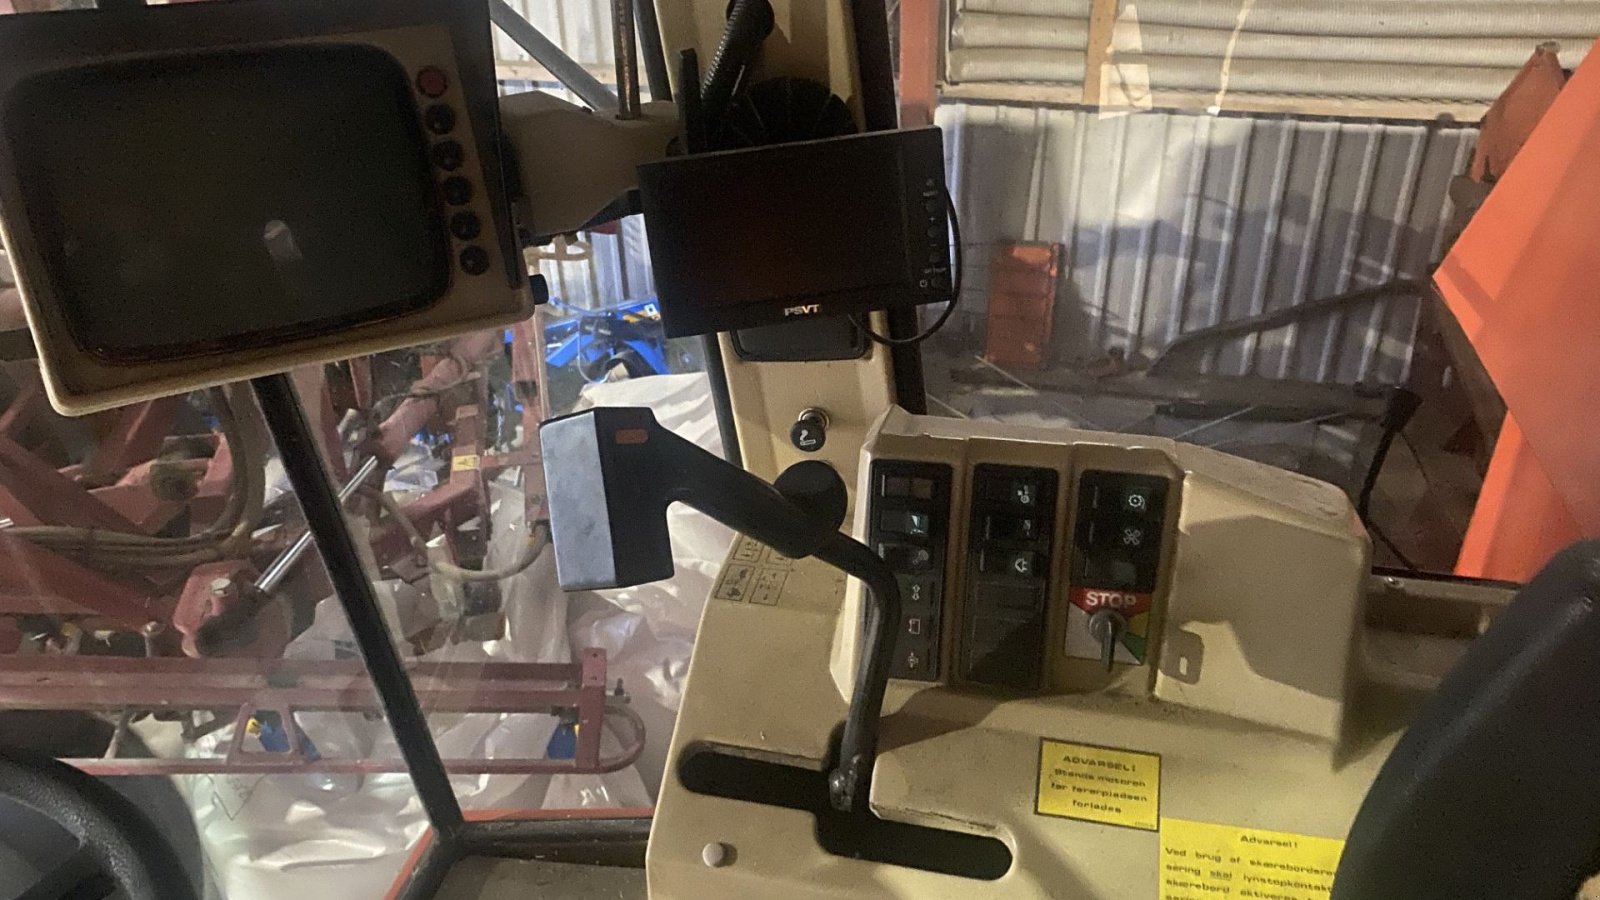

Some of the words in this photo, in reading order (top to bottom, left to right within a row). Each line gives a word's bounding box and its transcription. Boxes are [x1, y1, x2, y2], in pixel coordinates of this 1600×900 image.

[784, 304, 820, 316] PSVT
[1086, 591, 1137, 608] STOP
[1072, 799, 1122, 814] forlades
[1165, 847, 1187, 857] Ved
[1195, 850, 1222, 863] brug
